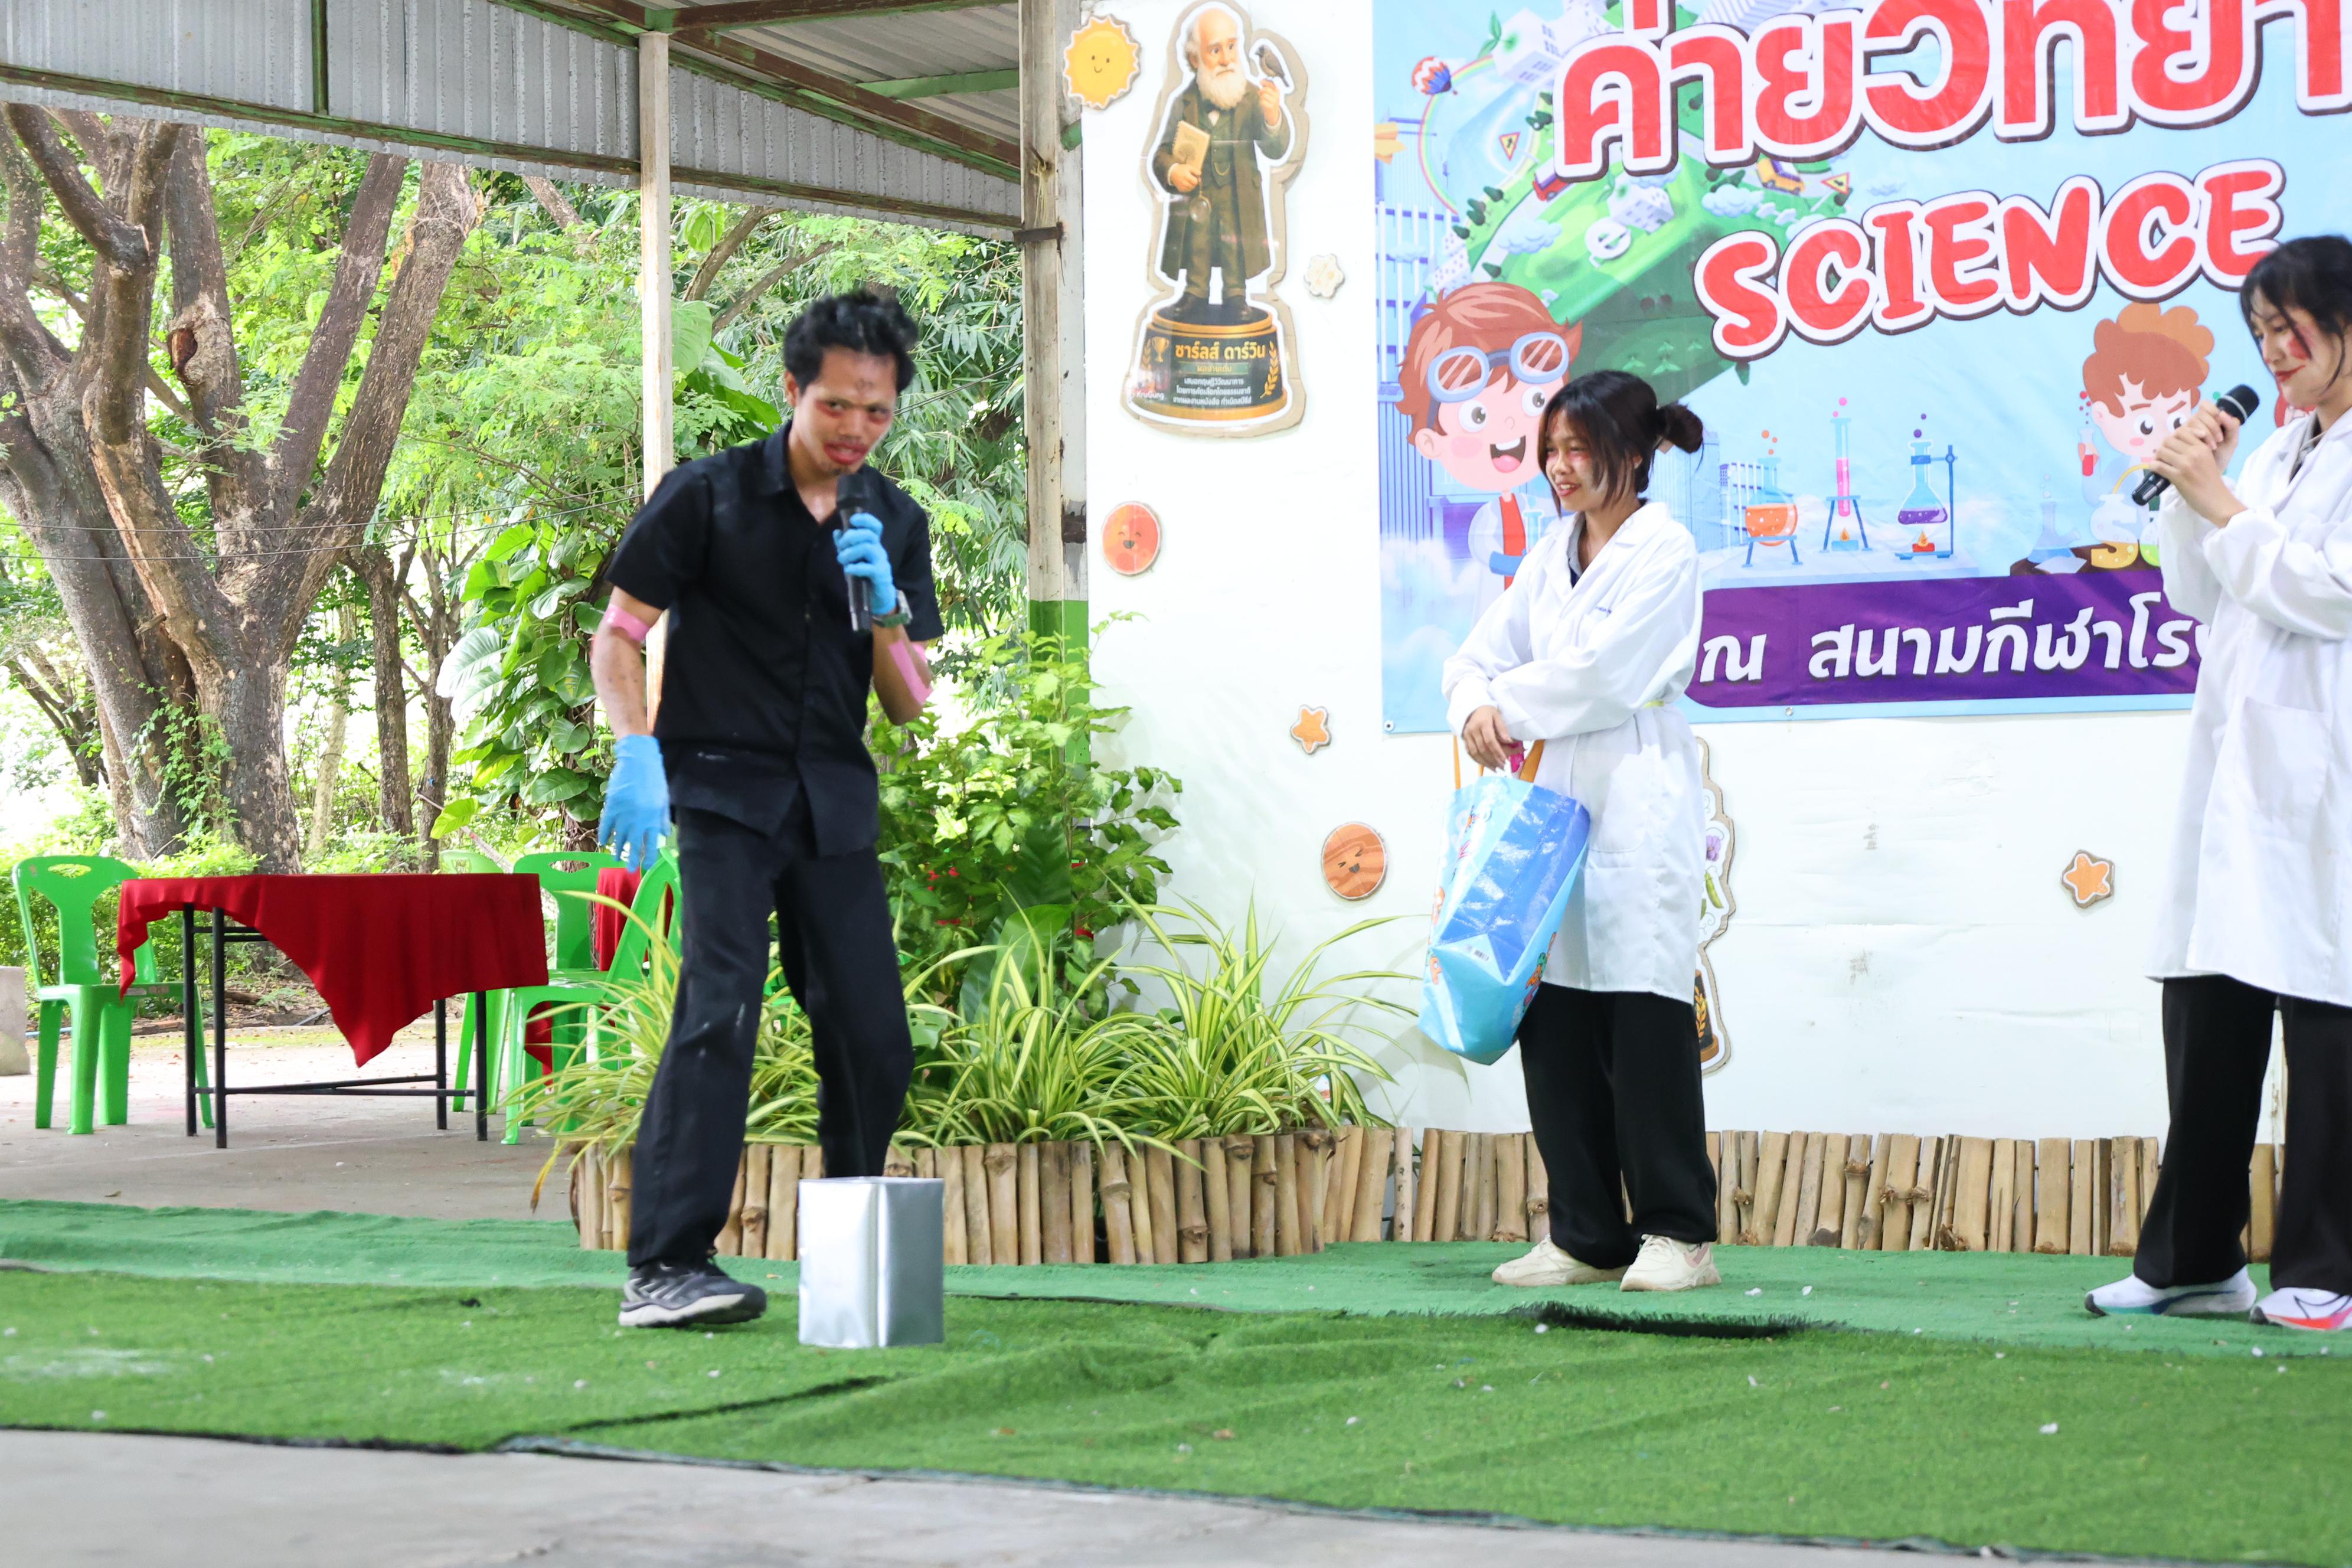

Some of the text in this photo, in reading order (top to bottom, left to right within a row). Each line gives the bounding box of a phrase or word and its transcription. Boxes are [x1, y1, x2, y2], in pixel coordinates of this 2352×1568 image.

[1696, 161, 2284, 358] SCIENCE
[1224, 341, 1266, 360] ดาร์วิน
[1698, 633, 1767, 684] ณ
